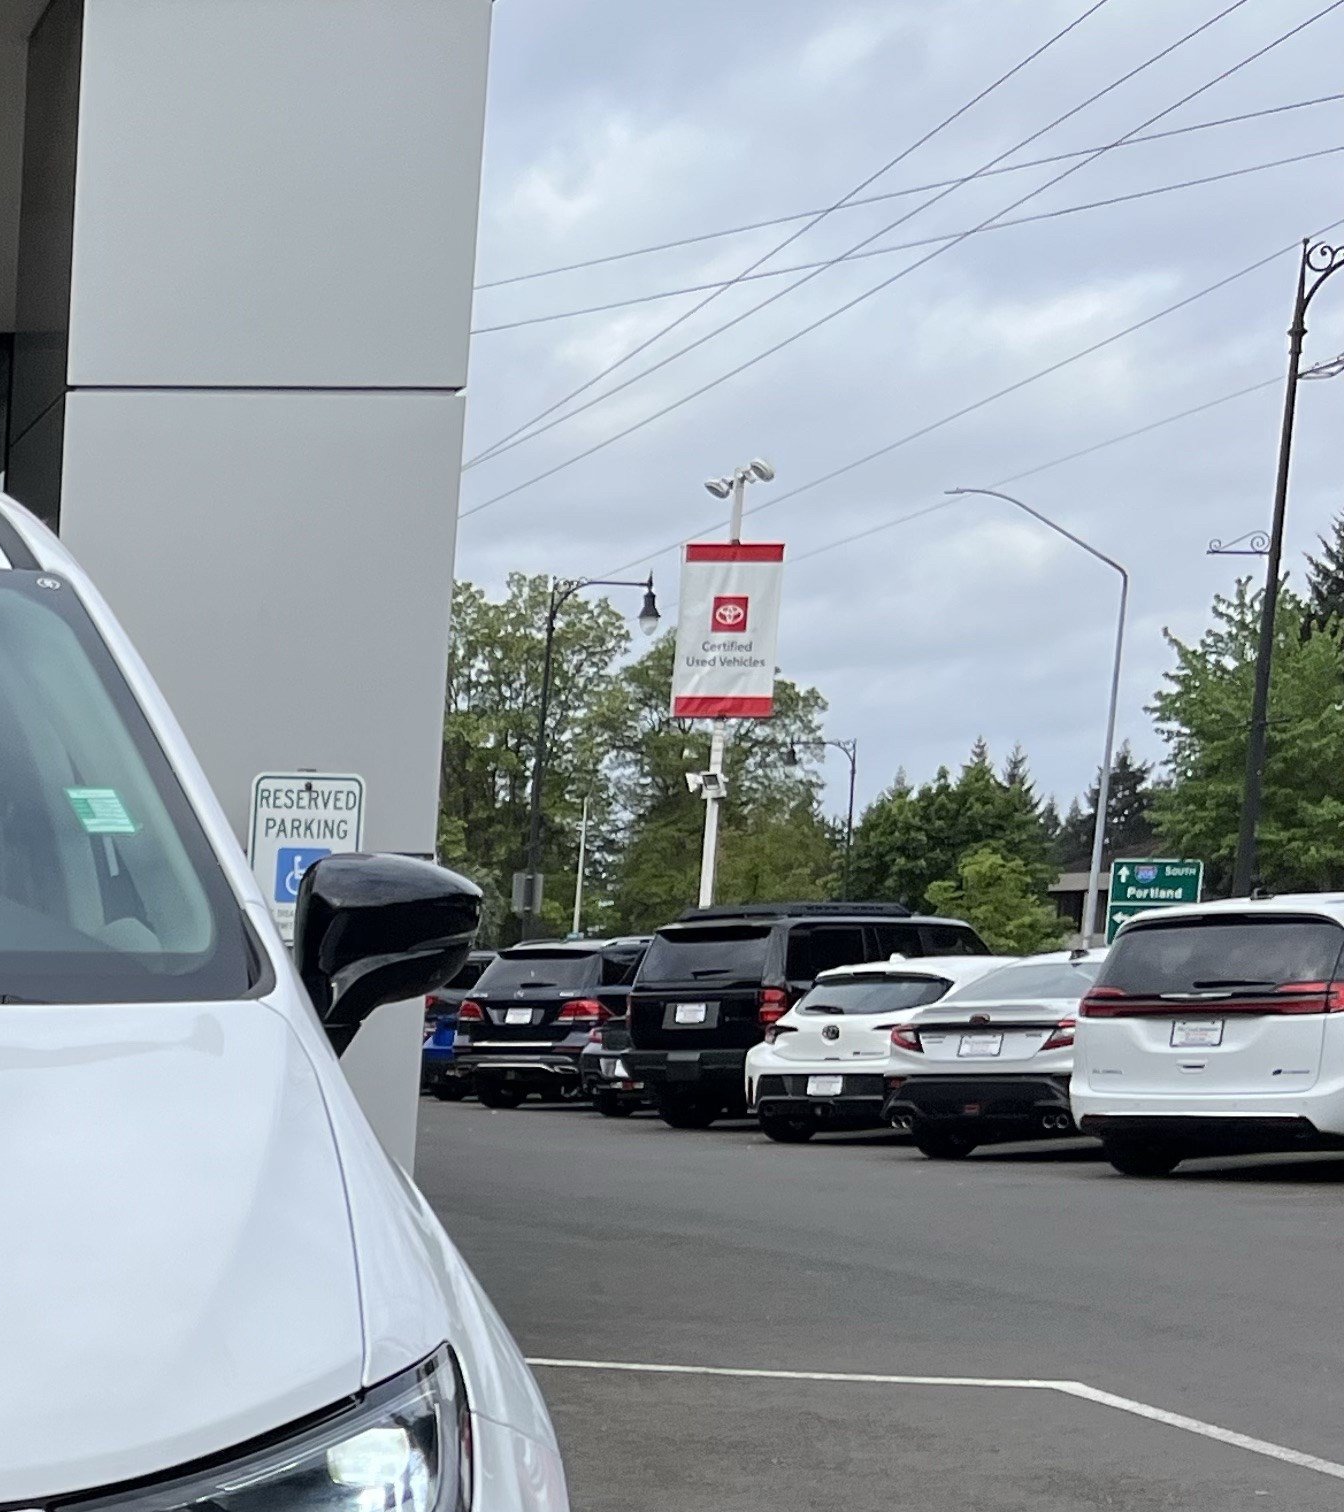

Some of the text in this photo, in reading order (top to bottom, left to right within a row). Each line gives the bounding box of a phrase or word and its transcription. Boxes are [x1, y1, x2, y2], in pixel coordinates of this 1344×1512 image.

[702, 640, 753, 653] Certified
[685, 656, 765, 668] Used Vehicles
[260, 789, 357, 811] RESERVED
[265, 818, 348, 840] PARKING
[1127, 886, 1182, 899] Portland
